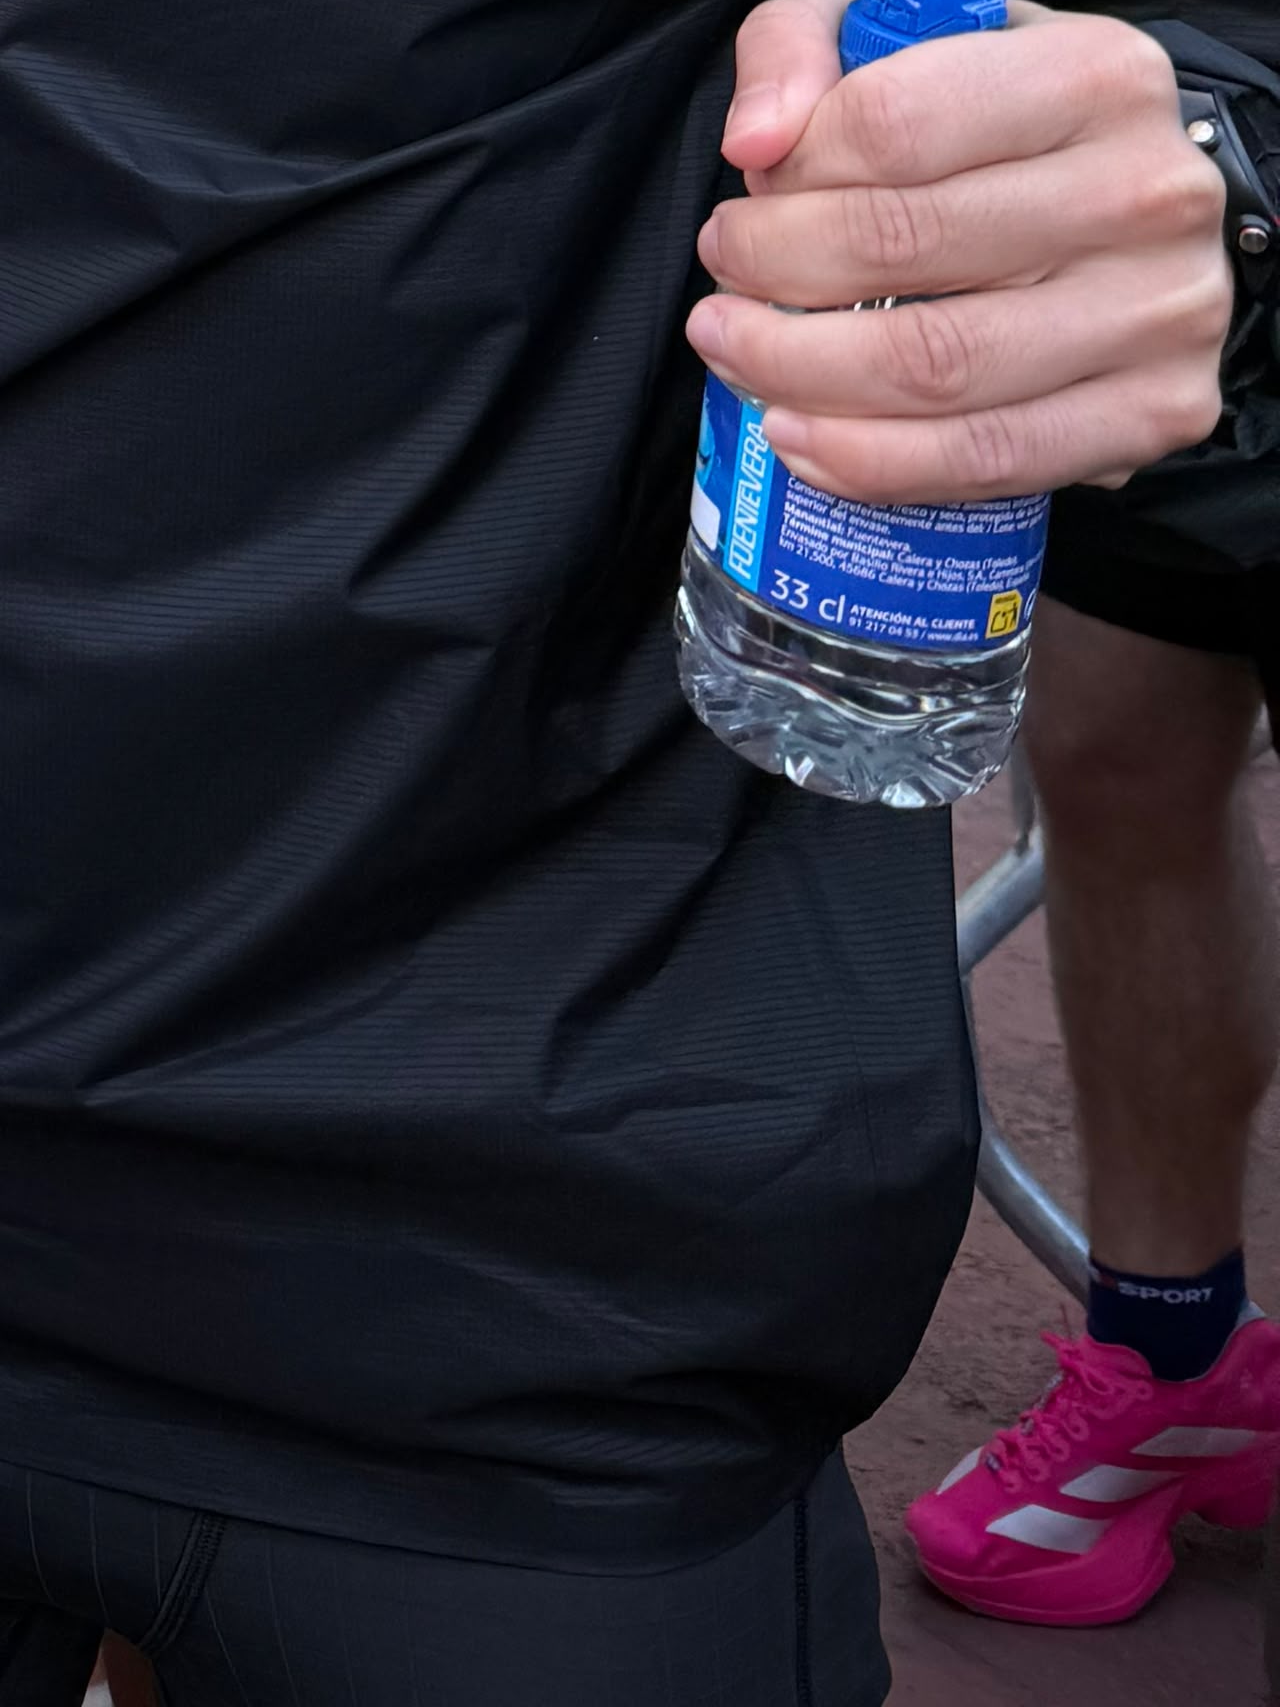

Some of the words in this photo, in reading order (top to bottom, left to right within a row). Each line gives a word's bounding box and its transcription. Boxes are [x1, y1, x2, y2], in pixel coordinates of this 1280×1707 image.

[728, 421, 769, 579] FUENTEVERA
[770, 568, 811, 611] 33
[818, 594, 846, 623] cl
[849, 604, 912, 625] ATENCIÓN
[913, 616, 929, 628] AL
[931, 618, 977, 630] CLIENTE
[865, 620, 887, 633] 217
[1117, 1281, 1215, 1304] SPORT
